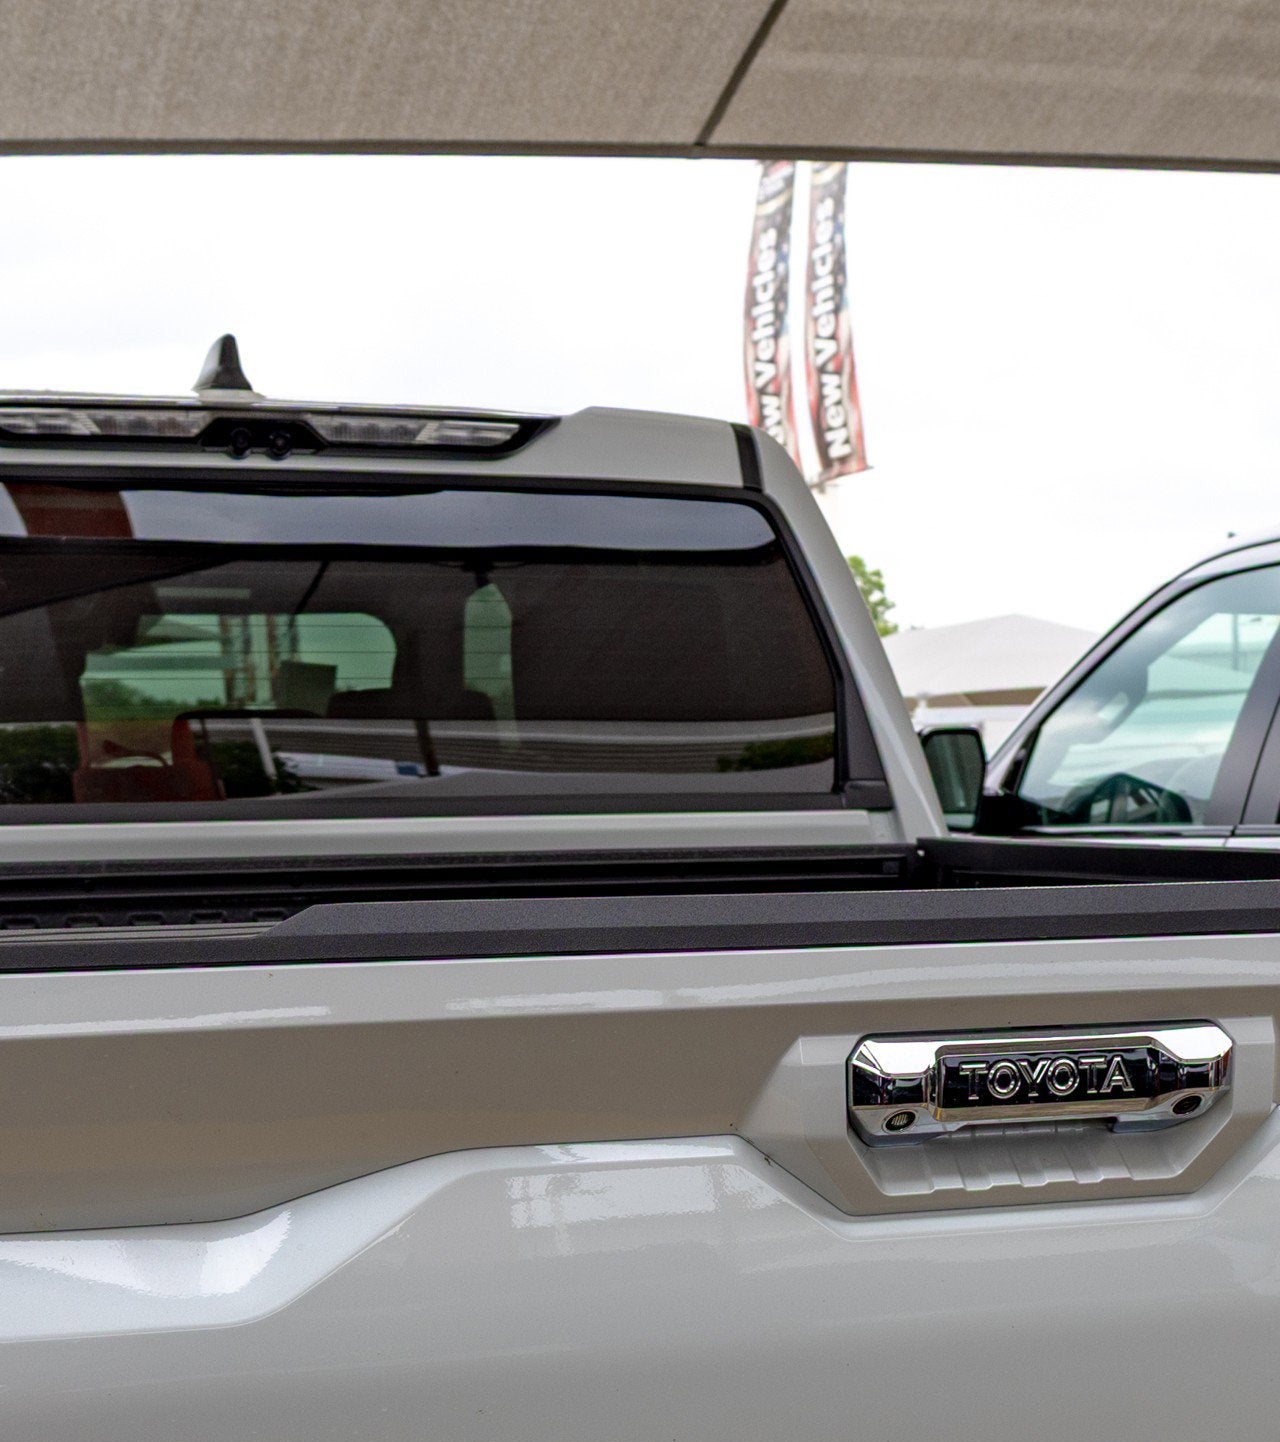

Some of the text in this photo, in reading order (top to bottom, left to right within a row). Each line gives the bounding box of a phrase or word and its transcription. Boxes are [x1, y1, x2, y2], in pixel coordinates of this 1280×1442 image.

[751, 227, 778, 390] Vehicles
[812, 197, 851, 459] New Vehicles
[760, 394, 786, 447] ew
[959, 1055, 1135, 1100] TOYOTA
